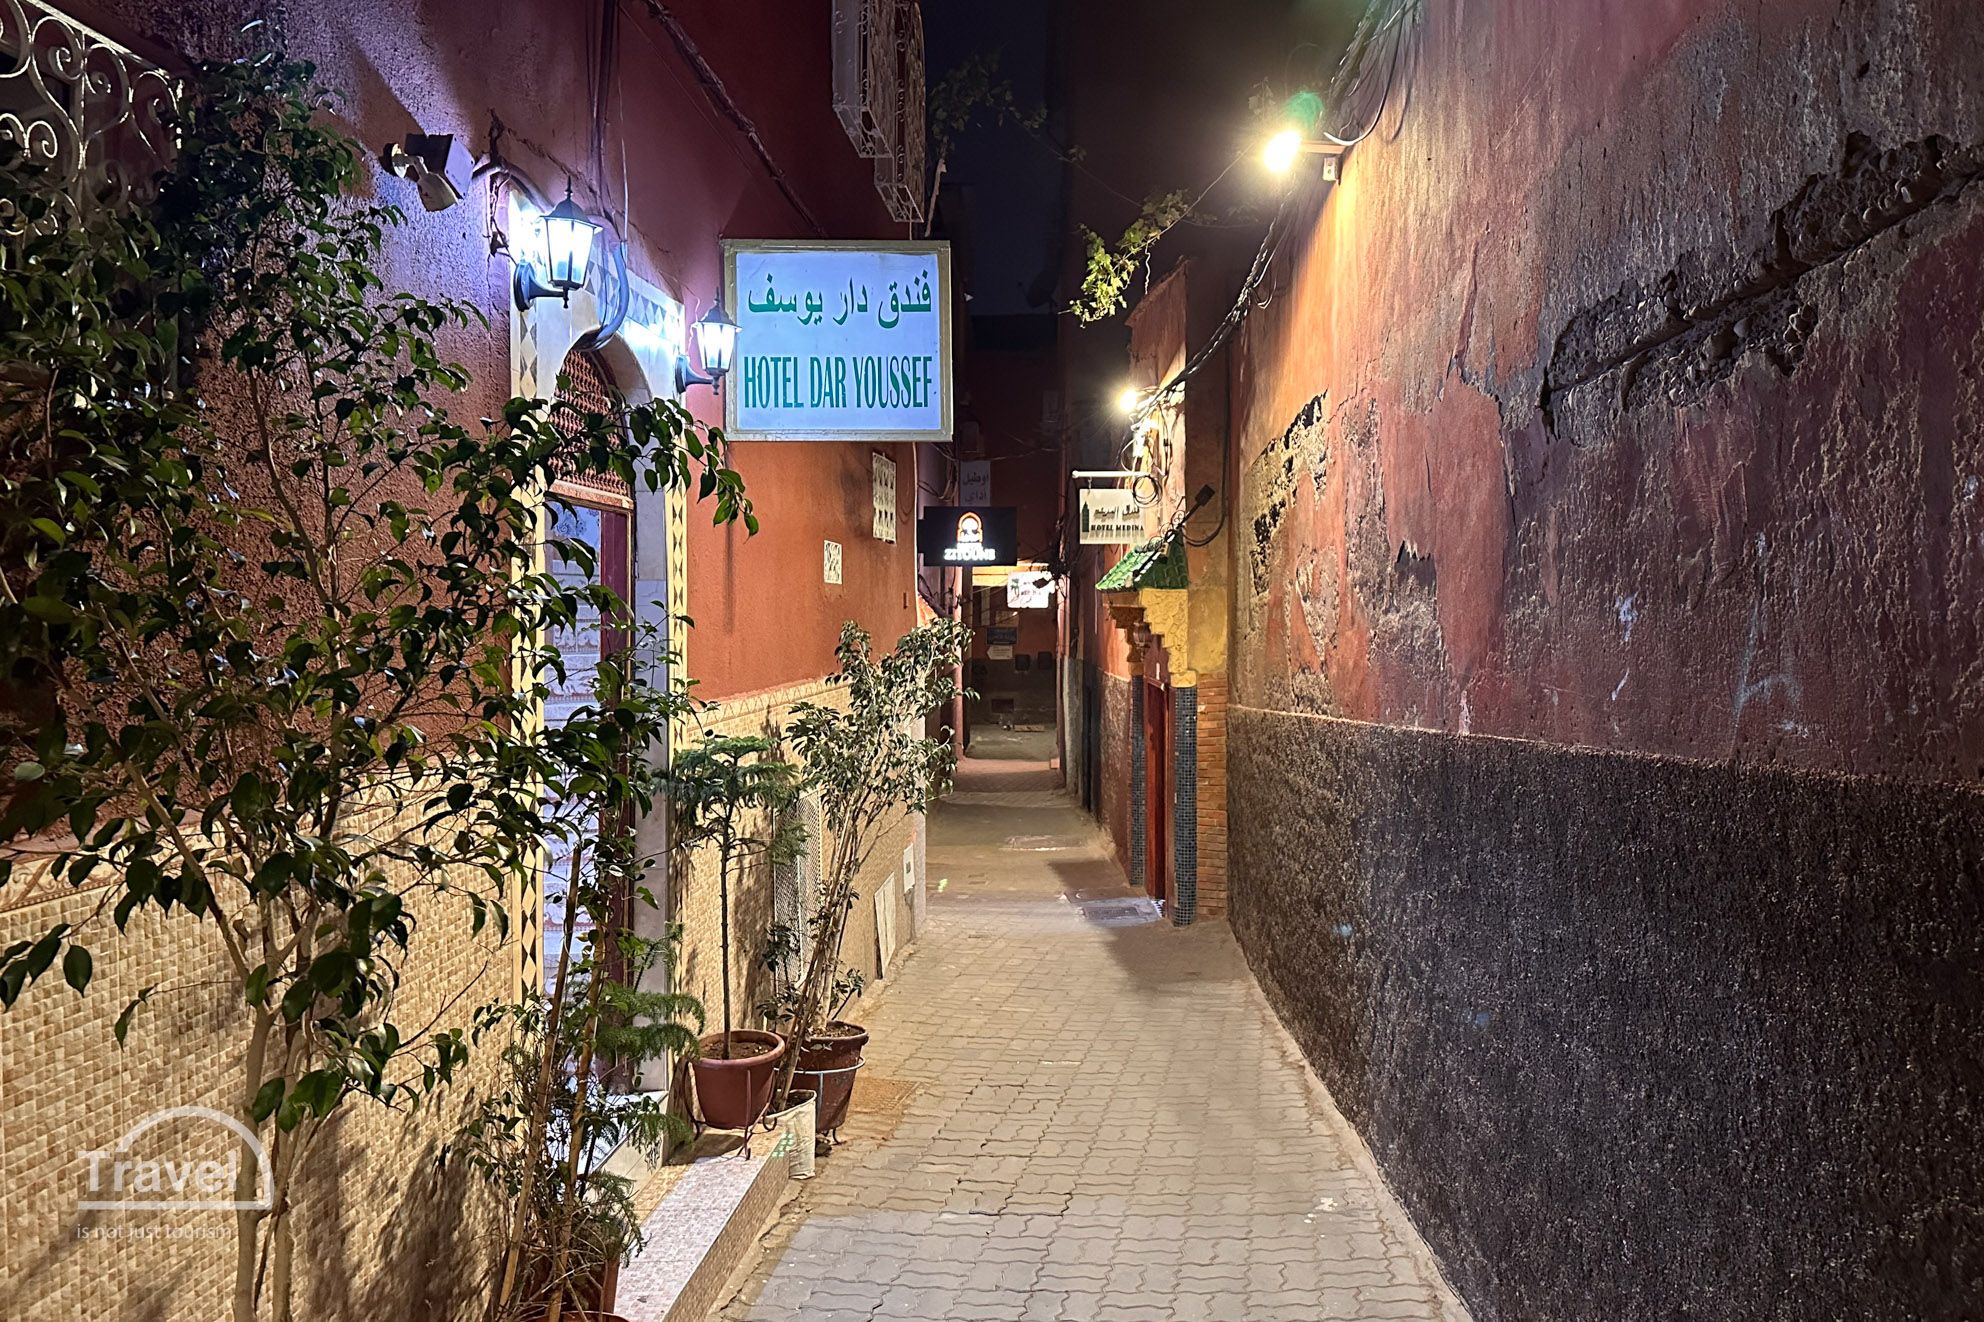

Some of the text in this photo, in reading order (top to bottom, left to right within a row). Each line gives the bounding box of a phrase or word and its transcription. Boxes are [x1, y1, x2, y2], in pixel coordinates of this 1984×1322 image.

[748, 269, 932, 329] فندق دار يوسف
[744, 356, 933, 409] HOTEL DAR YOUSSEF
